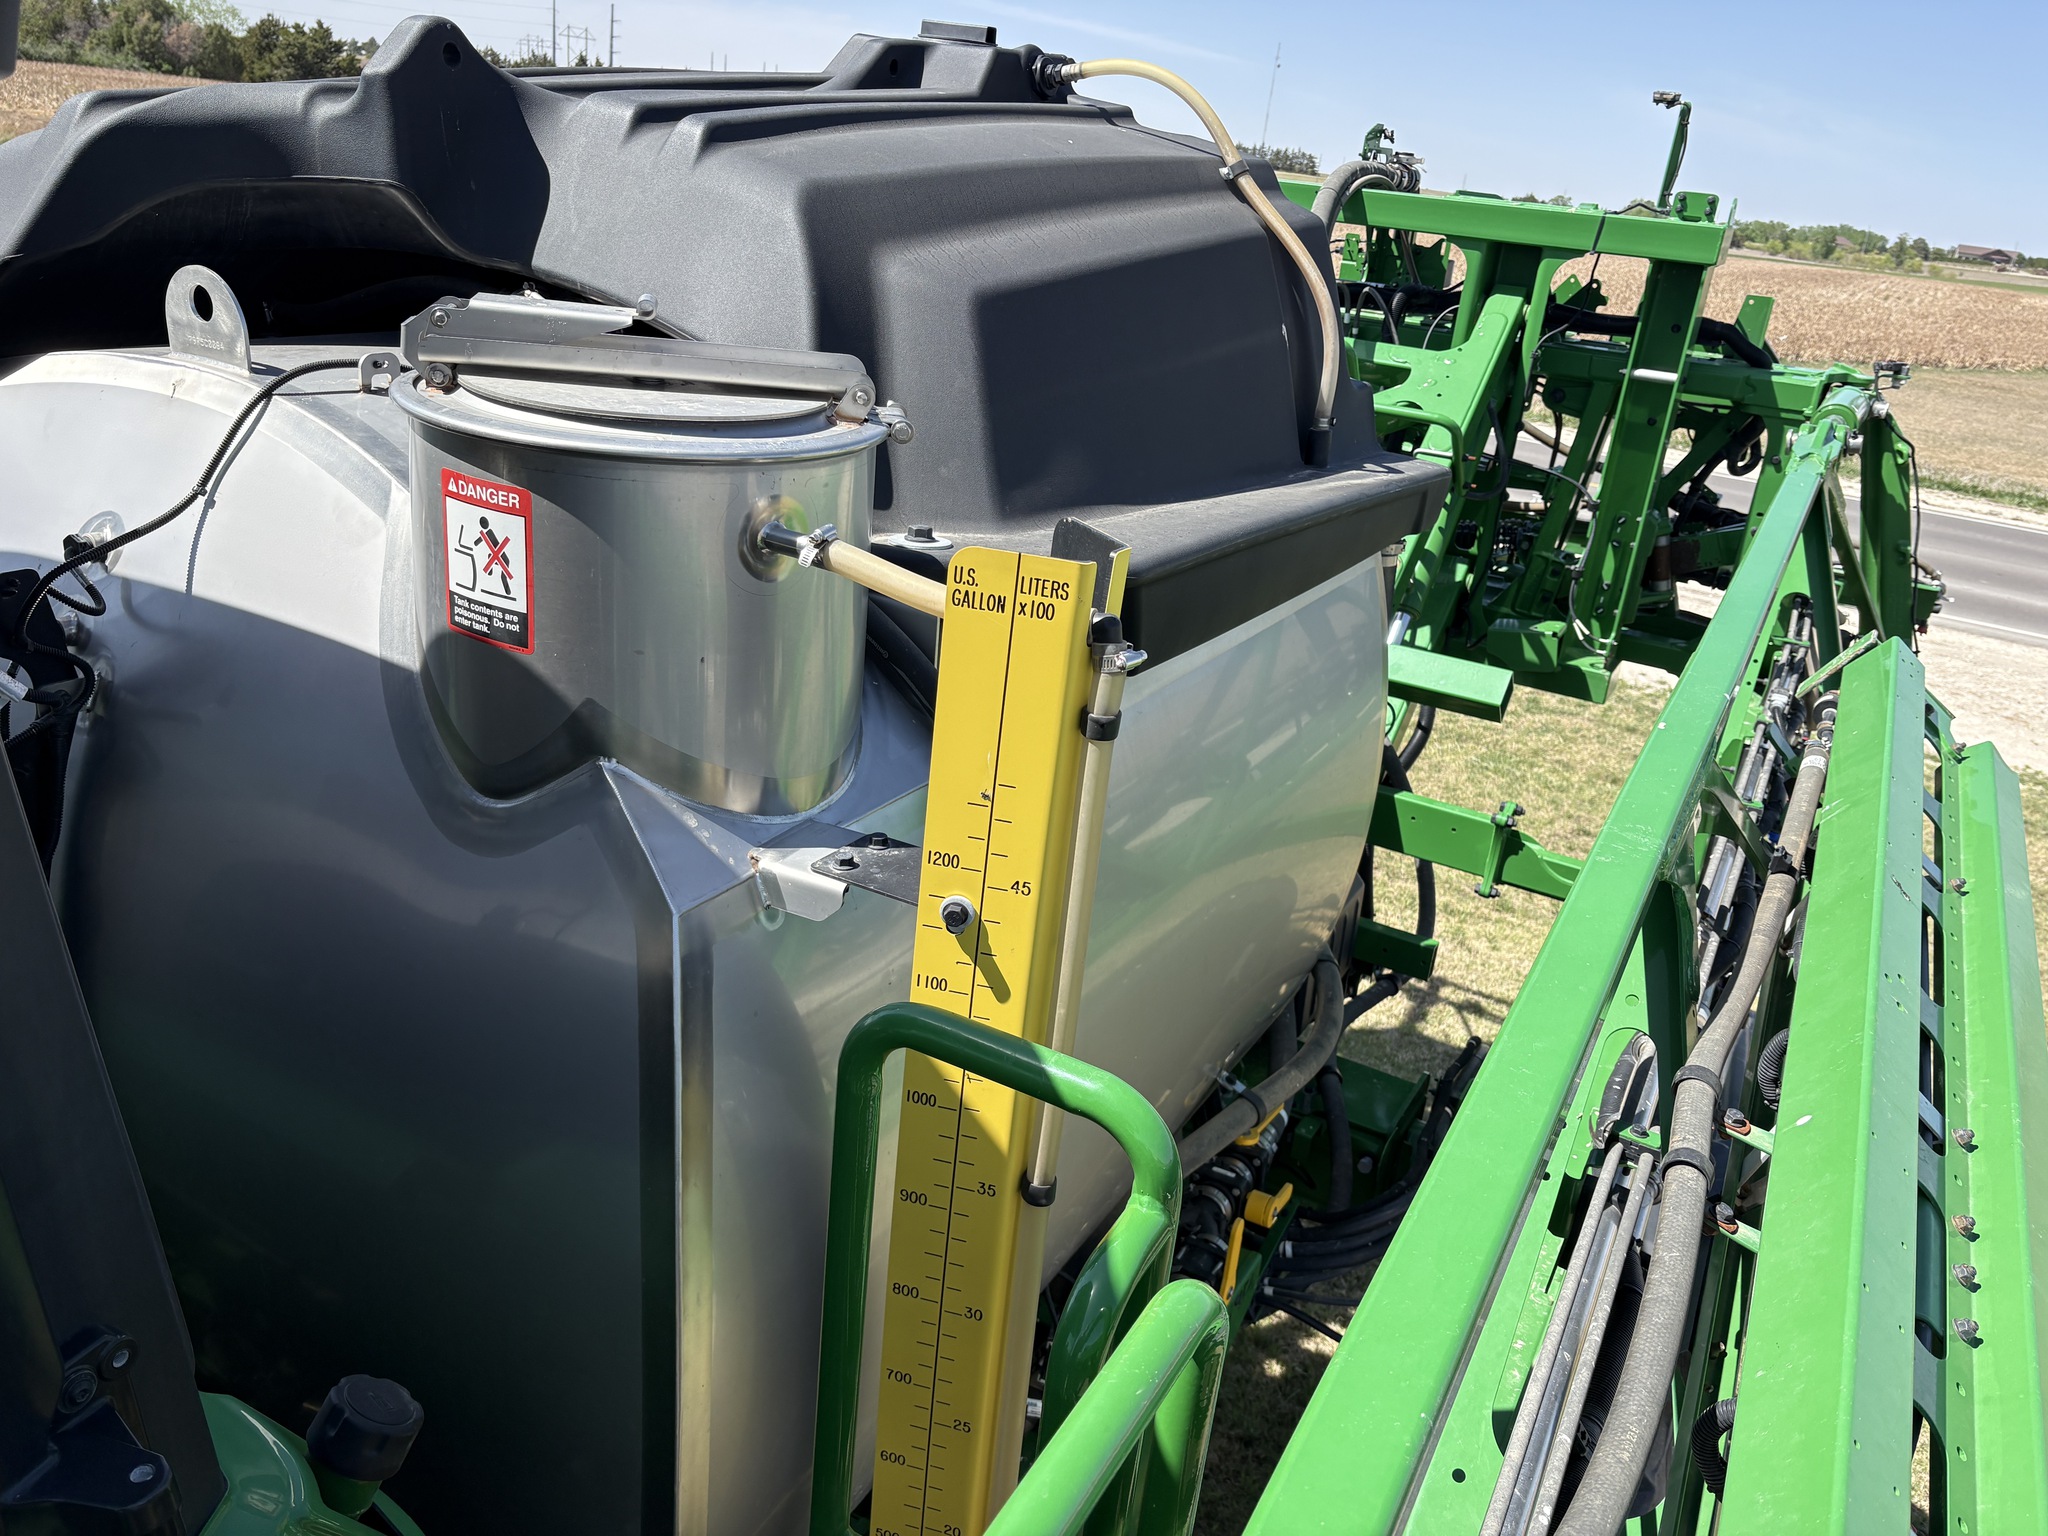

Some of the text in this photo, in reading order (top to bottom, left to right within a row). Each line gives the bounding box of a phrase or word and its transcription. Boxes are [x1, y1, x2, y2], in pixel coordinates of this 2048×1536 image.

[458, 480, 519, 508] DANGER
[953, 565, 979, 587] U.S.
[1020, 576, 1070, 601] LITERS
[453, 594, 519, 623] Tank contents are
[952, 589, 1007, 614] GALLON
[1018, 599, 1055, 621] x100
[454, 606, 520, 633] poisonous. Do not
[454, 615, 491, 634] enter tank.
[927, 850, 960, 870] 1200
[1010, 881, 1031, 896] 45
[916, 973, 948, 992] 1100
[906, 1089, 937, 1108] 1000
[899, 1188, 928, 1206] 900
[976, 1181, 997, 1198] 35
[892, 1282, 920, 1299] 800
[964, 1306, 983, 1322] 30
[886, 1368, 912, 1385] 700
[953, 1419, 971, 1434] 25
[880, 1450, 906, 1466] 600
[944, 1524, 961, 1536] 20
